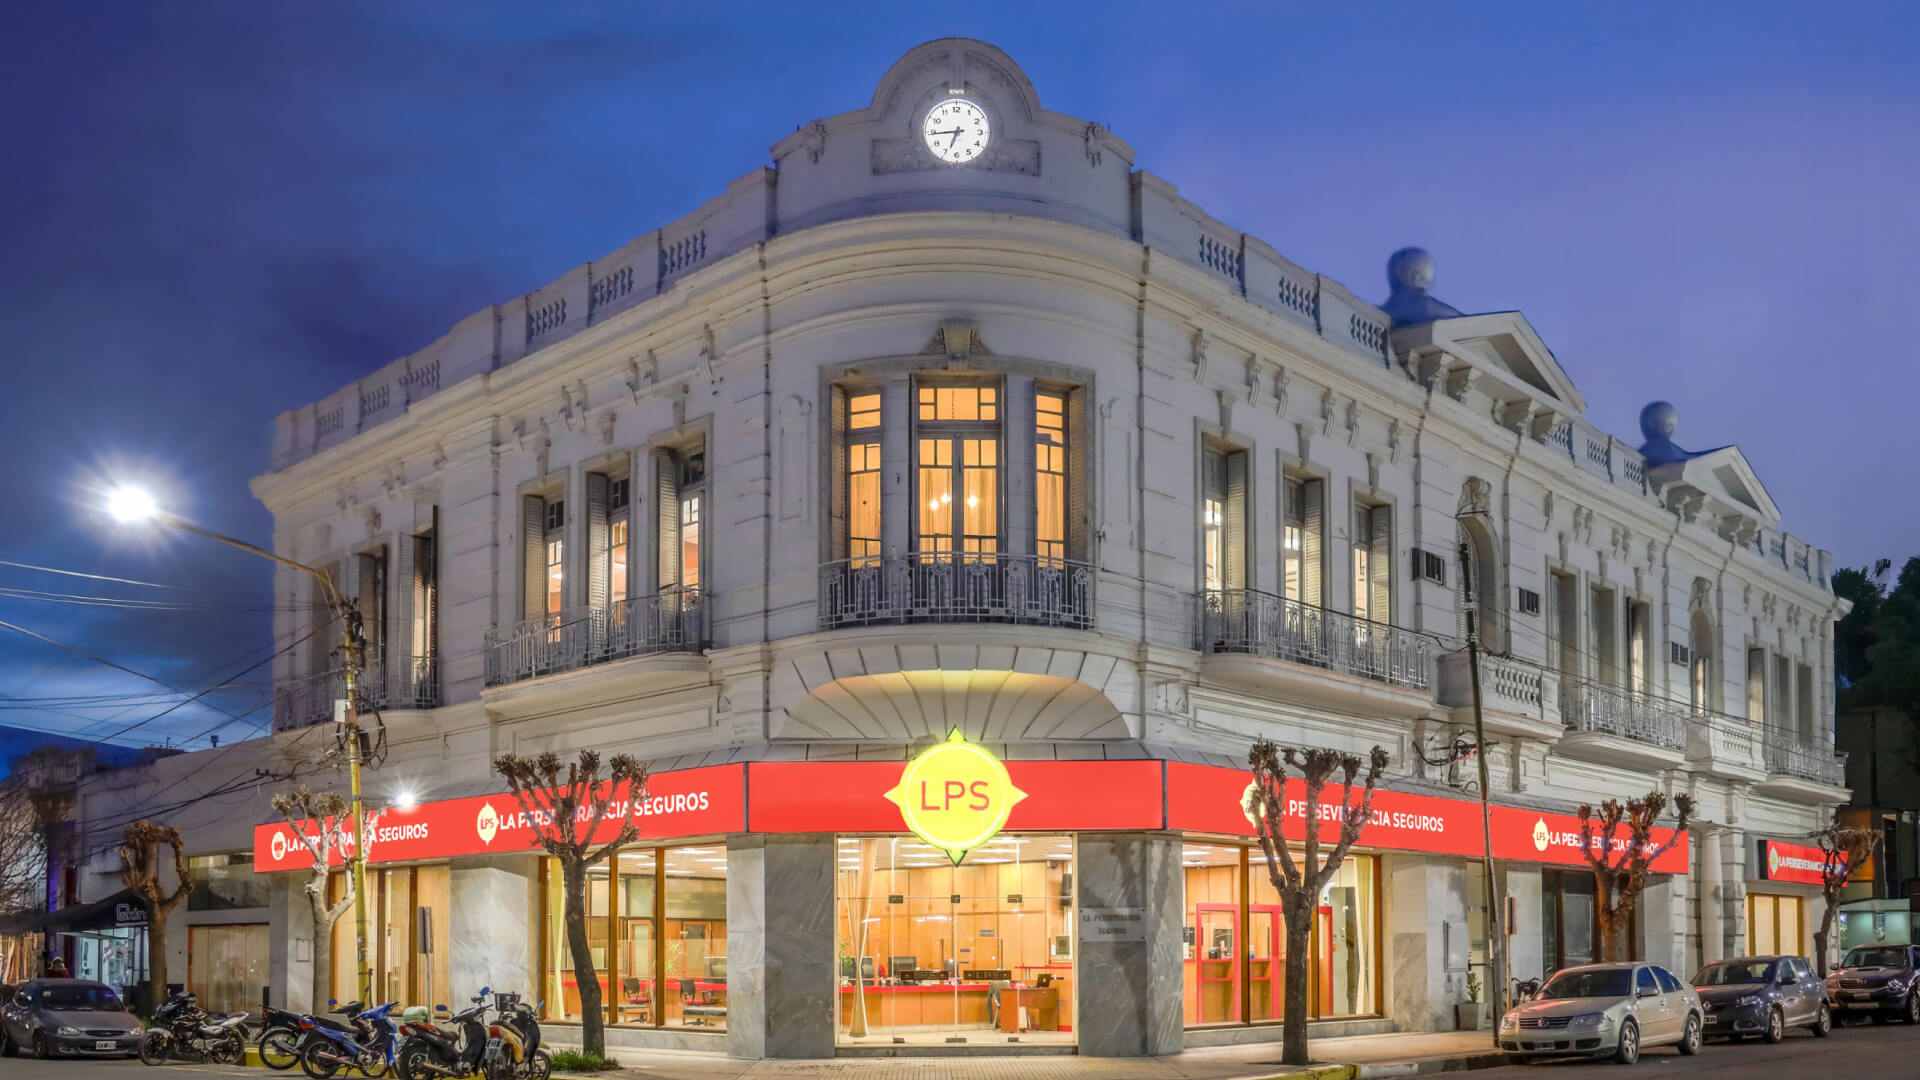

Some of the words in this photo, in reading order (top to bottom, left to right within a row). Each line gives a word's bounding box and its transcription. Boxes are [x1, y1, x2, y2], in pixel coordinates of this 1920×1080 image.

[921, 780, 990, 811] LPS
[500, 813, 516, 830] LA
[634, 791, 709, 816] SEGUROS
[1393, 811, 1444, 833] SEGUROS
[287, 838, 299, 852] LA
[379, 822, 429, 843] SEGUROS
[481, 818, 494, 830] LPS
[1549, 831, 1560, 845] LA
